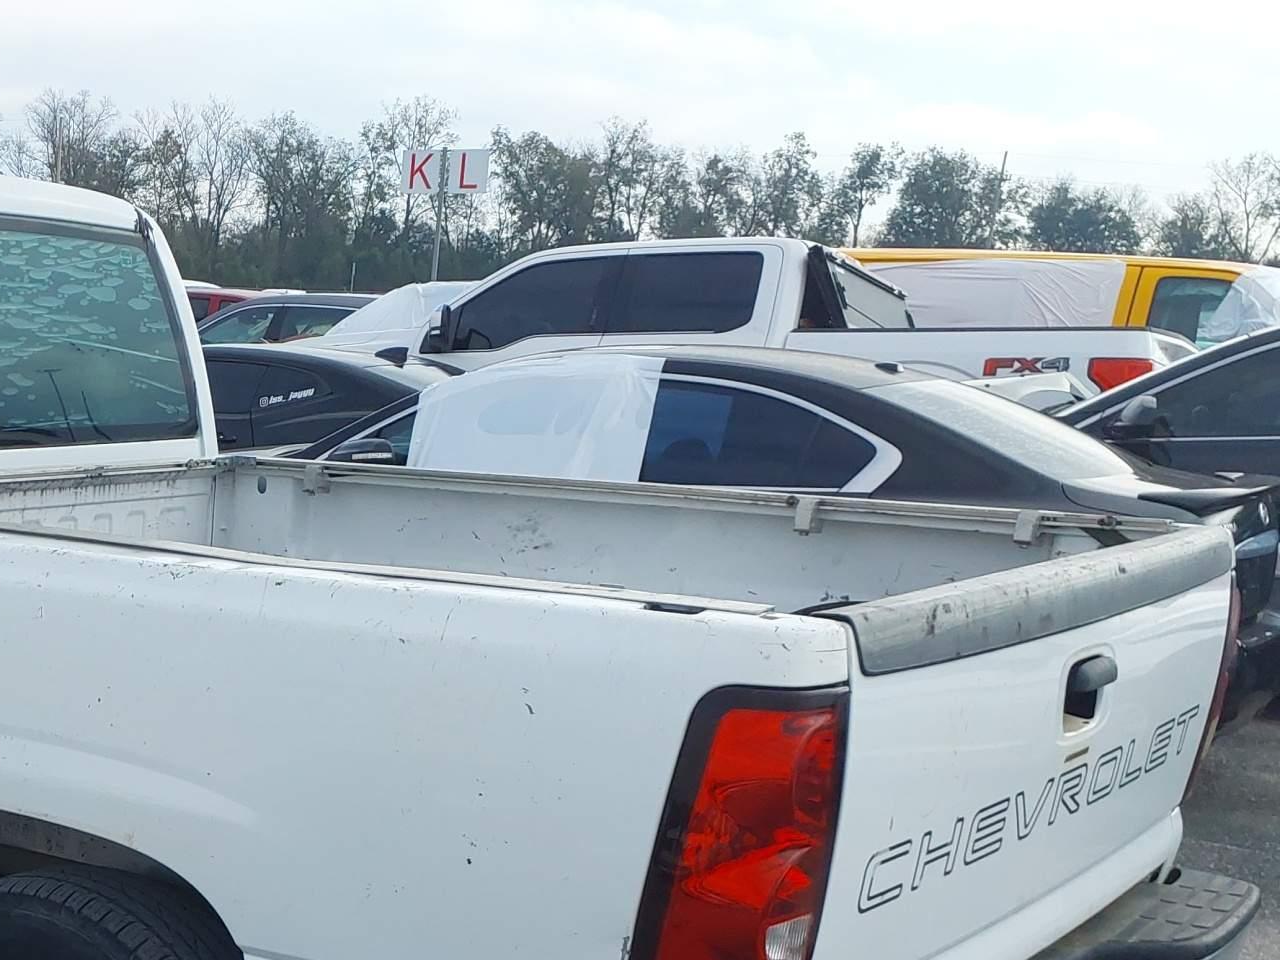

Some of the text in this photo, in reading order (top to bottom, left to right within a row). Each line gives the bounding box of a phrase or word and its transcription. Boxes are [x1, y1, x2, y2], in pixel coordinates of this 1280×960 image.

[408, 153, 434, 189] K
[458, 152, 478, 189] L
[982, 357, 1070, 377] FX4
[858, 704, 1200, 913] CHEVROLET
